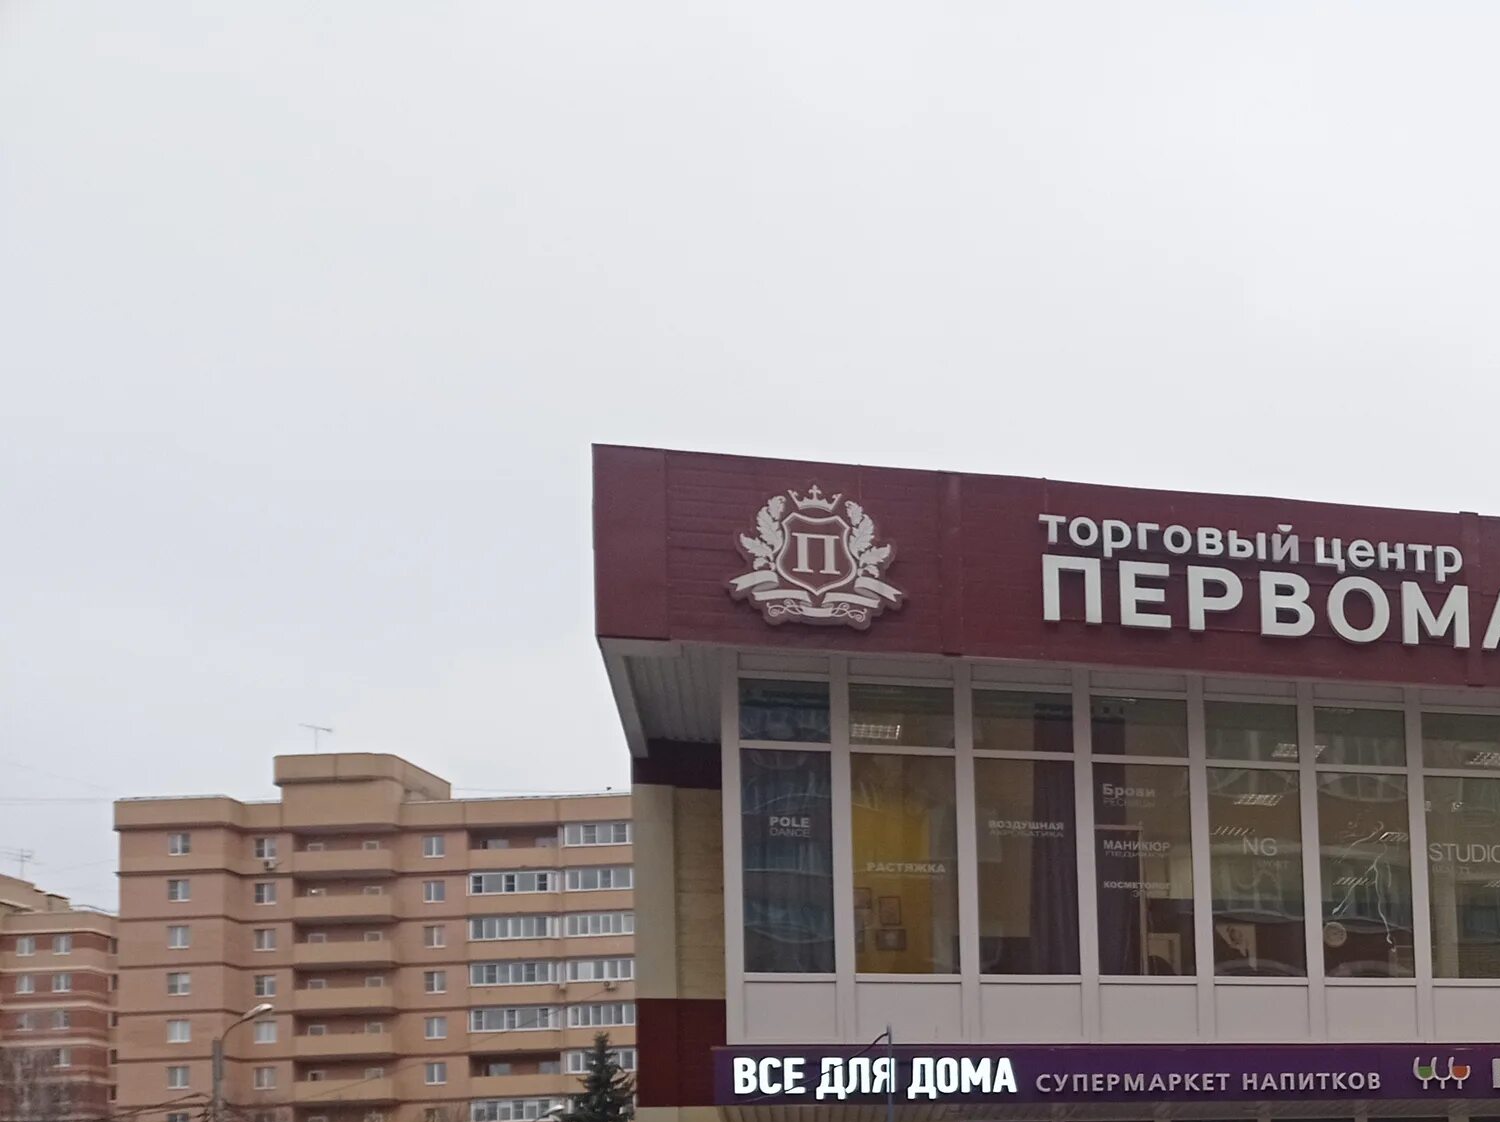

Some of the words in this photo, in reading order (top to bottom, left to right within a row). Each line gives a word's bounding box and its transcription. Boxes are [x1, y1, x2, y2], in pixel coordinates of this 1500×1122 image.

[1038, 513, 1300, 564] торговый
[1314, 534, 1465, 583] центр
[768, 816, 811, 828] POLE
[988, 820, 1065, 831] ВОЗДУШНАЯ
[1103, 840, 1170, 852] МАНИКЮР
[1242, 835, 1279, 857] NG
[866, 862, 947, 873] РАСТЯЖКА
[733, 1056, 807, 1095] ВСЕ
[815, 1056, 896, 1101] ДЛЯ
[907, 1056, 1018, 1100] ДОМА
[1034, 1071, 1231, 1094] СУПЕРМАРКЕТ
[1242, 1070, 1382, 1091] НАПИТКОВ
